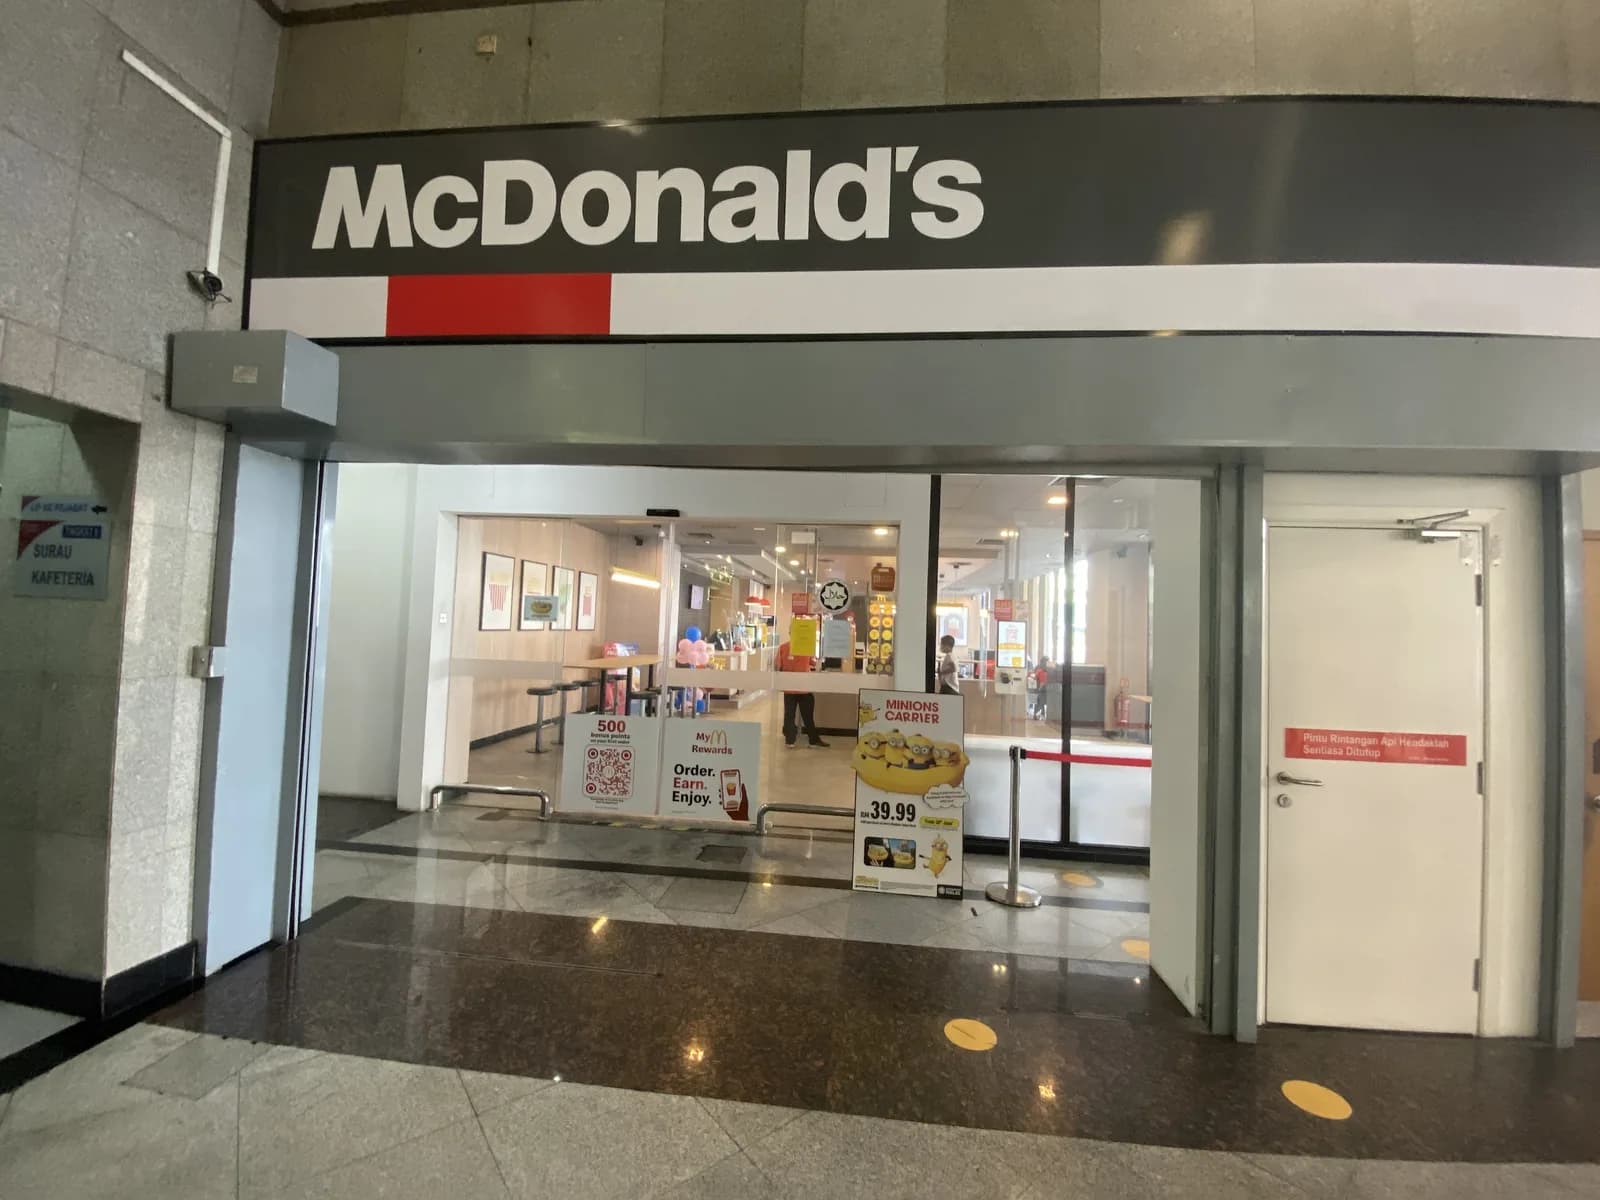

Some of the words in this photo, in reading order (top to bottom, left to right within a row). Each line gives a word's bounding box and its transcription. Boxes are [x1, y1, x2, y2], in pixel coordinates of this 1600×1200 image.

[312, 145, 985, 249] McDonald's
[33, 544, 72, 559] SURAU
[31, 570, 95, 586] KAFETERIA
[886, 700, 939, 712] MINIONS
[885, 711, 939, 724] CARRIER
[598, 720, 626, 732] 500
[696, 732, 710, 743] My
[1303, 733, 1328, 743] Pintu
[1330, 734, 1378, 747] Rintangan
[1381, 736, 1397, 748] Api
[692, 745, 733, 755] Rewards
[1303, 745, 1343, 755] Sentiasa
[1346, 746, 1381, 758] Ditutup
[674, 764, 715, 777] Order.
[673, 778, 707, 790] Earn.
[672, 791, 711, 807] Enjoy.
[870, 801, 916, 822] 39.99
